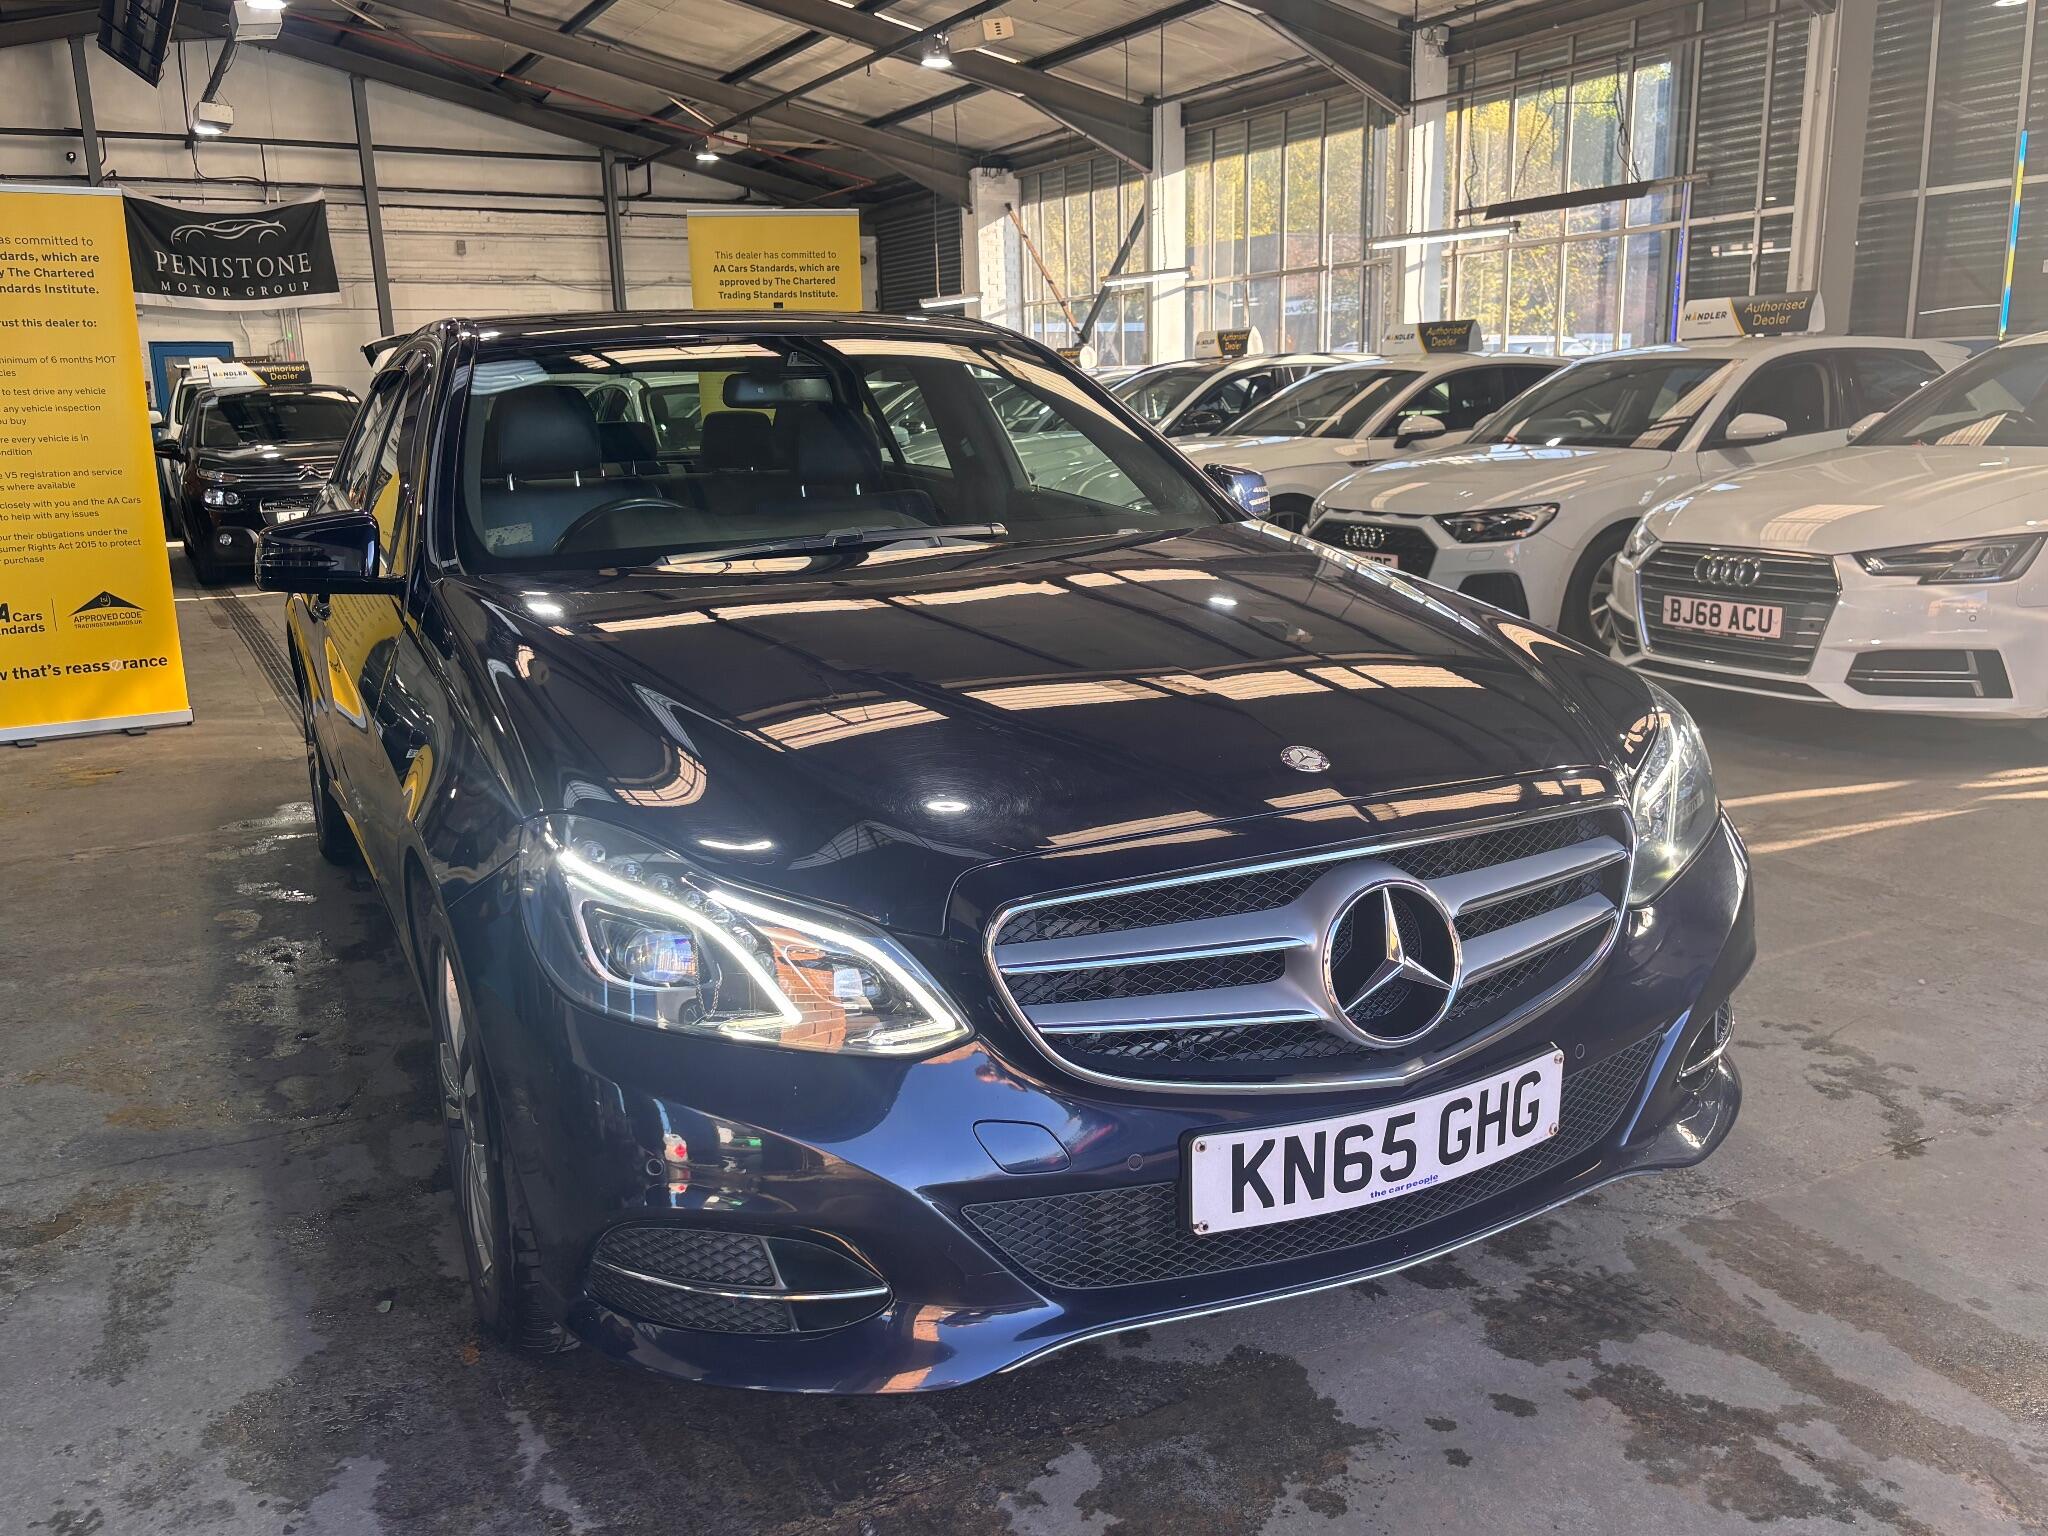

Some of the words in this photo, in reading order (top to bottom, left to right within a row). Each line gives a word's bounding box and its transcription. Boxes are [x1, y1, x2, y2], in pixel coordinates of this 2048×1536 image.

[14, 236, 78, 246] committed
[82, 236, 94, 246] to
[42, 252, 78, 262] which
[715, 251, 733, 260] This
[736, 251, 762, 260] dealer
[764, 251, 779, 259] has
[780, 251, 826, 259] committed
[828, 251, 836, 259] to
[154, 250, 312, 278] PENISTONE
[714, 264, 726, 272] AA
[750, 264, 797, 273] Standards,
[799, 264, 825, 272] which
[7, 268, 30, 277] The
[34, 268, 94, 278] Chartered
[720, 278, 760, 288] approved
[763, 278, 772, 287] by
[774, 278, 791, 286] The
[793, 276, 836, 286] Chartered
[44, 284, 100, 294] Institute.
[161, 280, 231, 296] MOTOR
[246, 281, 309, 296] GROUP
[718, 290, 752, 300] Trading
[754, 290, 798, 300] Standards
[800, 290, 838, 298] Institute.
[1745, 298, 1808, 314] Authorised
[0, 318, 20, 328] ust
[22, 318, 42, 328] this
[45, 318, 80, 328] dealer
[82, 318, 97, 328] to:
[1753, 314, 1791, 326] Dealer
[1432, 336, 1456, 347] Dealer
[50, 356, 58, 364] 6
[96, 356, 116, 364] MOT
[261, 364, 306, 374] Authorised
[270, 372, 298, 380] Dealer
[75, 386, 106, 395] vehicle
[21, 404, 52, 412] vehicle
[55, 404, 101, 412] inspection
[10, 417, 26, 426] buy
[12, 436, 36, 444] every
[38, 434, 70, 443] vehicle
[20, 470, 71, 480] registration
[92, 468, 122, 476] service
[7, 483, 34, 491] where
[38, 482, 76, 490] available
[0, 502, 30, 510] closely
[33, 500, 52, 508] with
[108, 496, 120, 504] AA
[122, 496, 141, 504] Cars
[12, 512, 30, 522] help
[33, 511, 52, 520] with
[54, 512, 70, 520] any
[14, 532, 34, 540] their
[36, 530, 84, 540] obligations
[86, 528, 112, 537] under
[114, 528, 128, 536] the
[28, 543, 56, 553] Rights
[58, 542, 74, 550] Act
[76, 540, 97, 549] 2015
[110, 538, 142, 549] protect
[4, 556, 44, 566] purchase
[12, 612, 42, 622] Cars
[74, 612, 118, 624] APPROVED
[120, 612, 142, 620] CODE
[1670, 598, 1722, 628] BJ68
[1728, 605, 1773, 633] ACU
[0, 624, 46, 636] ndards
[12, 664, 61, 680] that's
[1231, 1111, 1417, 1214] KN65
[1438, 1070, 1542, 1166] GHG
[1370, 1190, 1386, 1198] the
[1388, 1184, 1405, 1194] car
[1406, 1174, 1438, 1190] people
